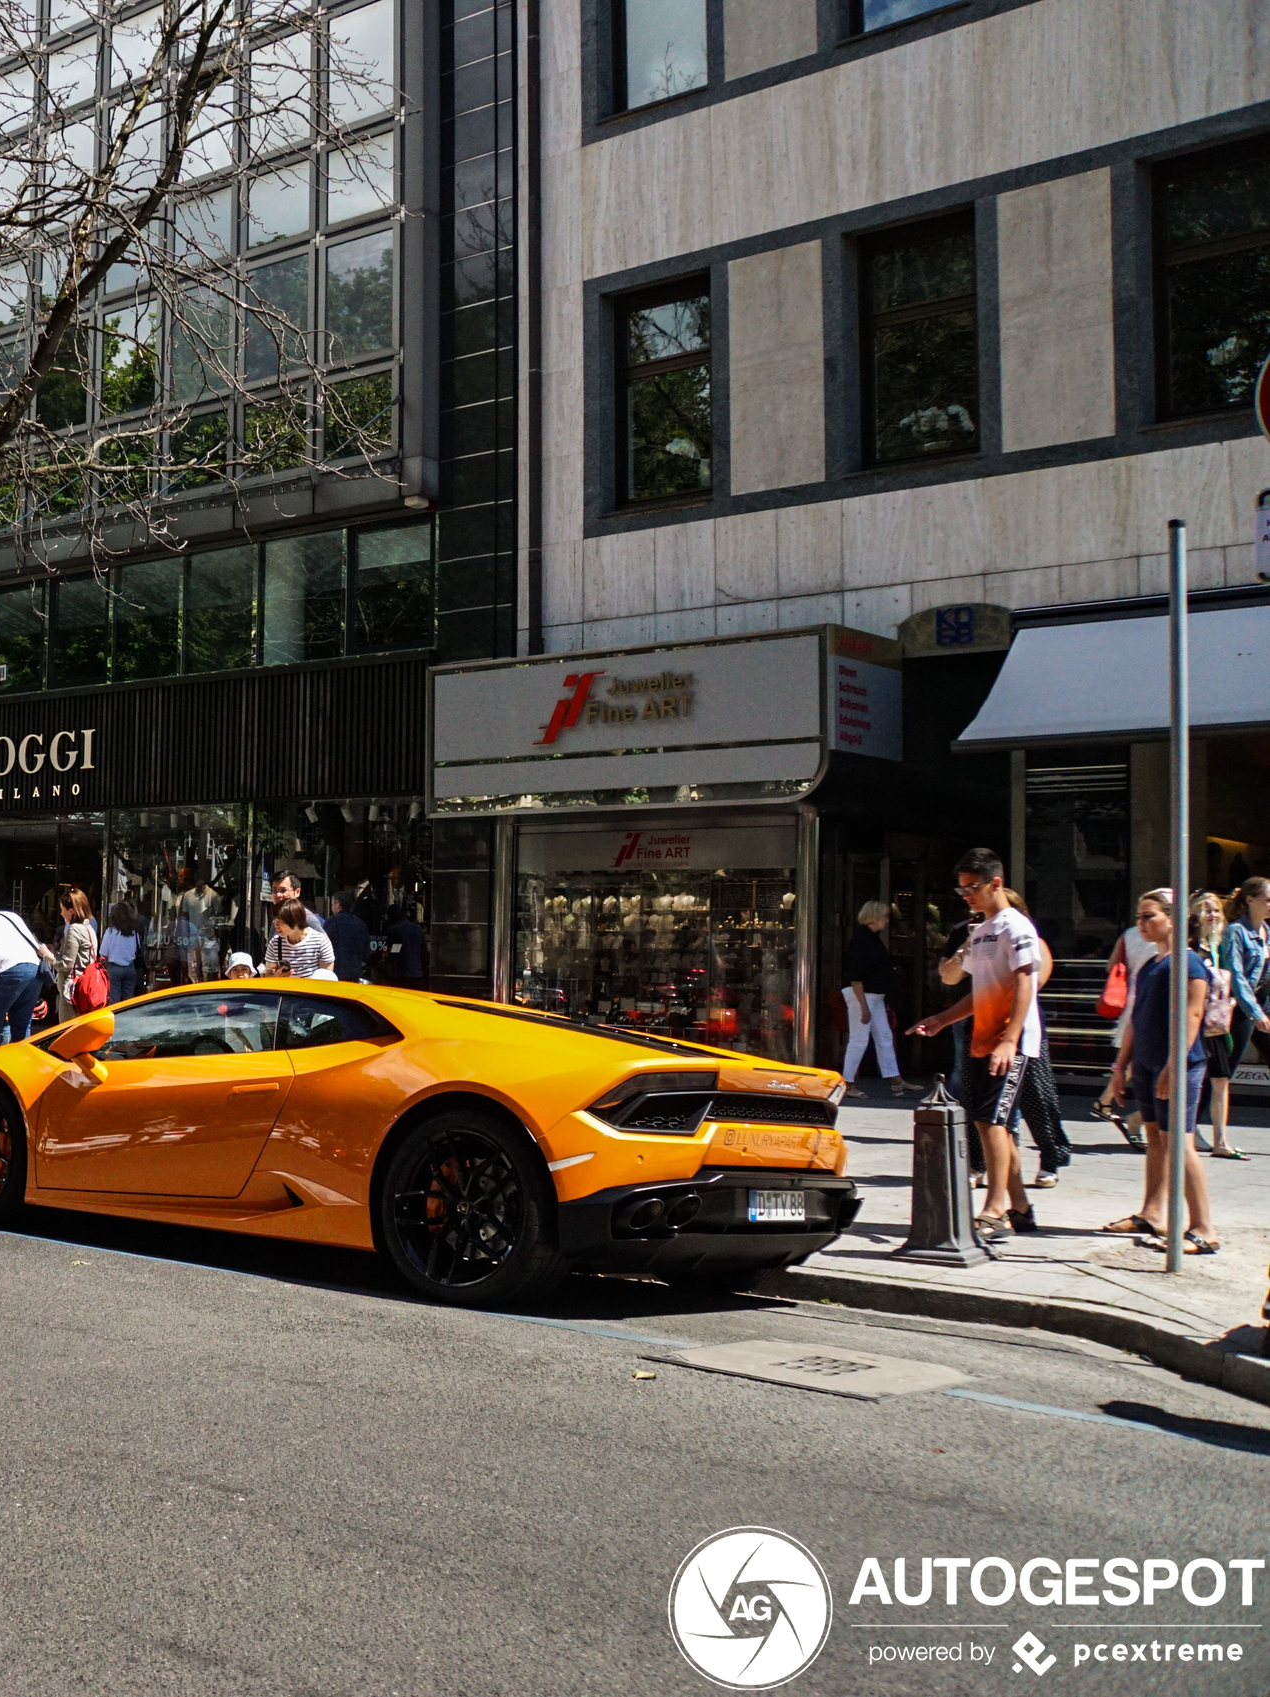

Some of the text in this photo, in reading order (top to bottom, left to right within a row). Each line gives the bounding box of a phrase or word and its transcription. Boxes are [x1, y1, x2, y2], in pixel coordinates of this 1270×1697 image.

[936, 606, 973, 628] KO
[839, 634, 874, 652] ANKAUF
[936, 626, 973, 647] 68
[838, 664, 858, 678] Uhren
[606, 670, 693, 696] Juwelier
[838, 681, 868, 697] Schmuck
[586, 694, 694, 725] Fine ART
[648, 834, 691, 845] Juwelier
[637, 847, 691, 859] Fine ART
[757, 1192, 804, 1217] D TY 88
